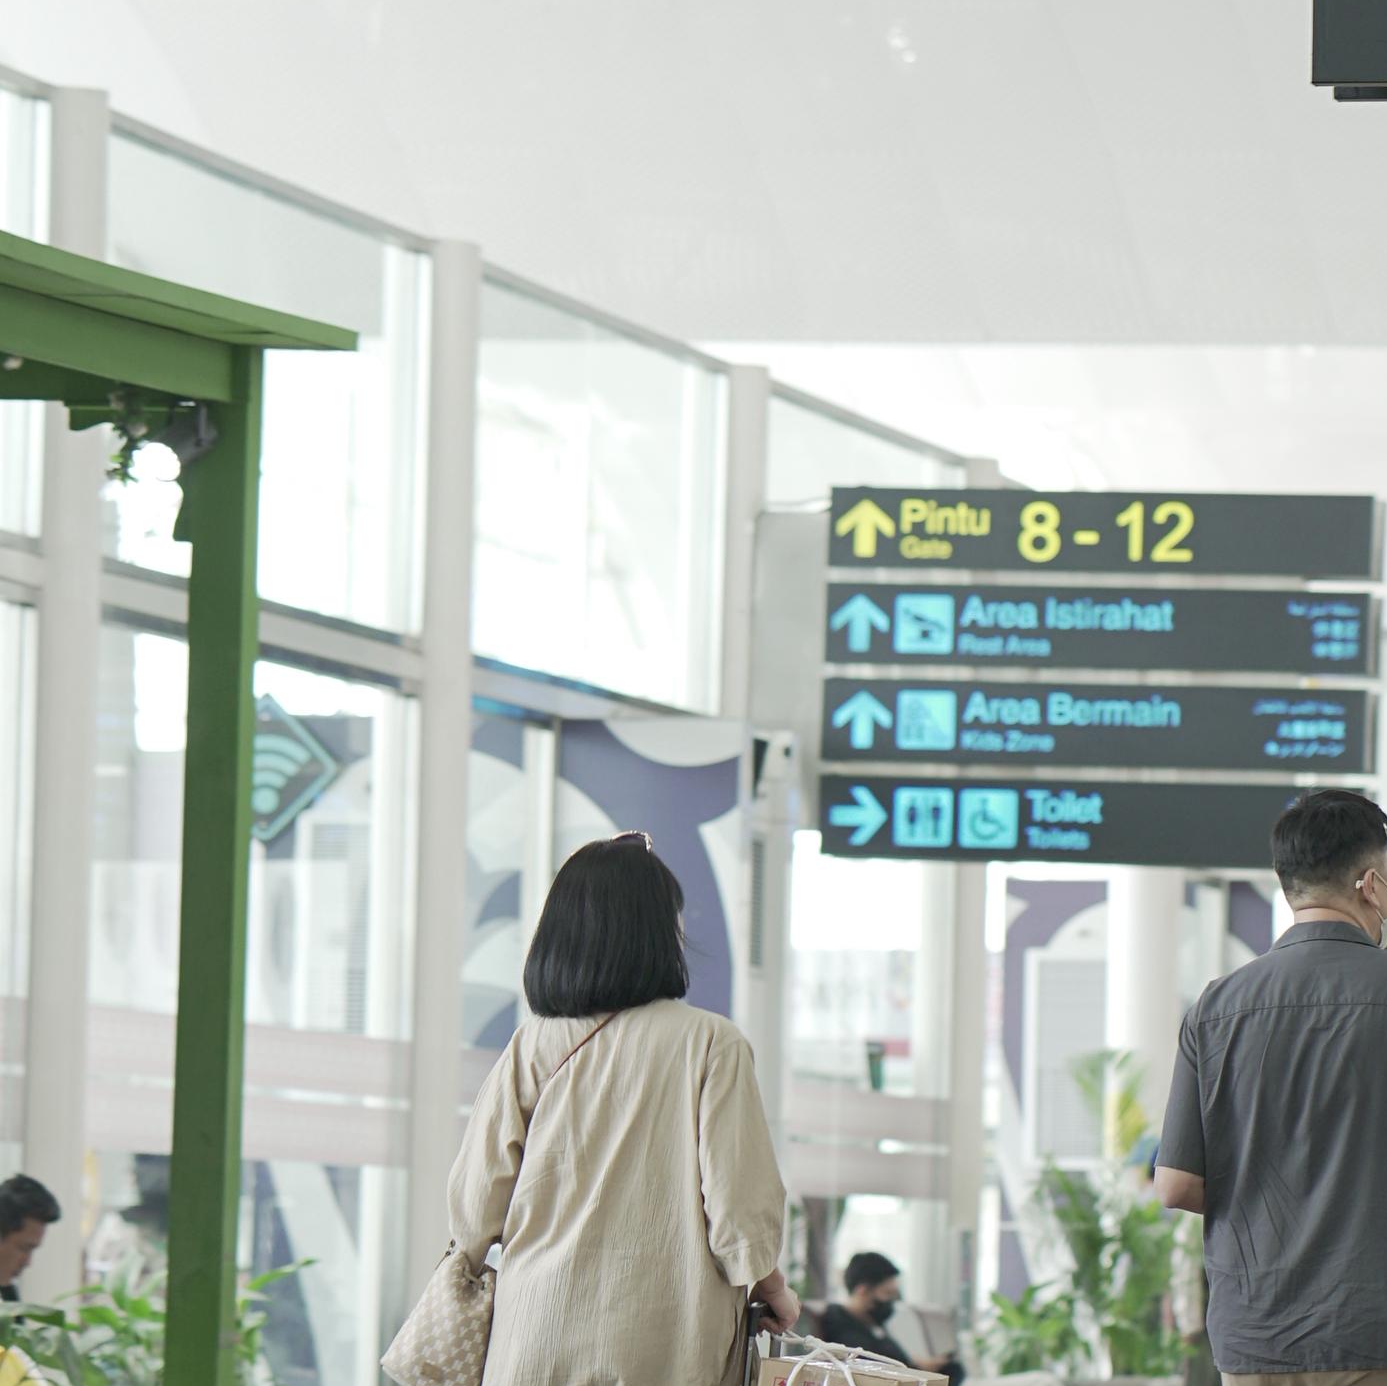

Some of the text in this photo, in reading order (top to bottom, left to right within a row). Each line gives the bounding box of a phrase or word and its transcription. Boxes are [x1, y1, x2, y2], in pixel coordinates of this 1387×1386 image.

[900, 498, 991, 536] Pintu
[1017, 500, 1062, 563] 8
[1116, 501, 1195, 563] 12
[959, 595, 1174, 632] Area Istirahat
[962, 691, 1181, 727] Area Bermain
[1025, 789, 1103, 824] Toilet
